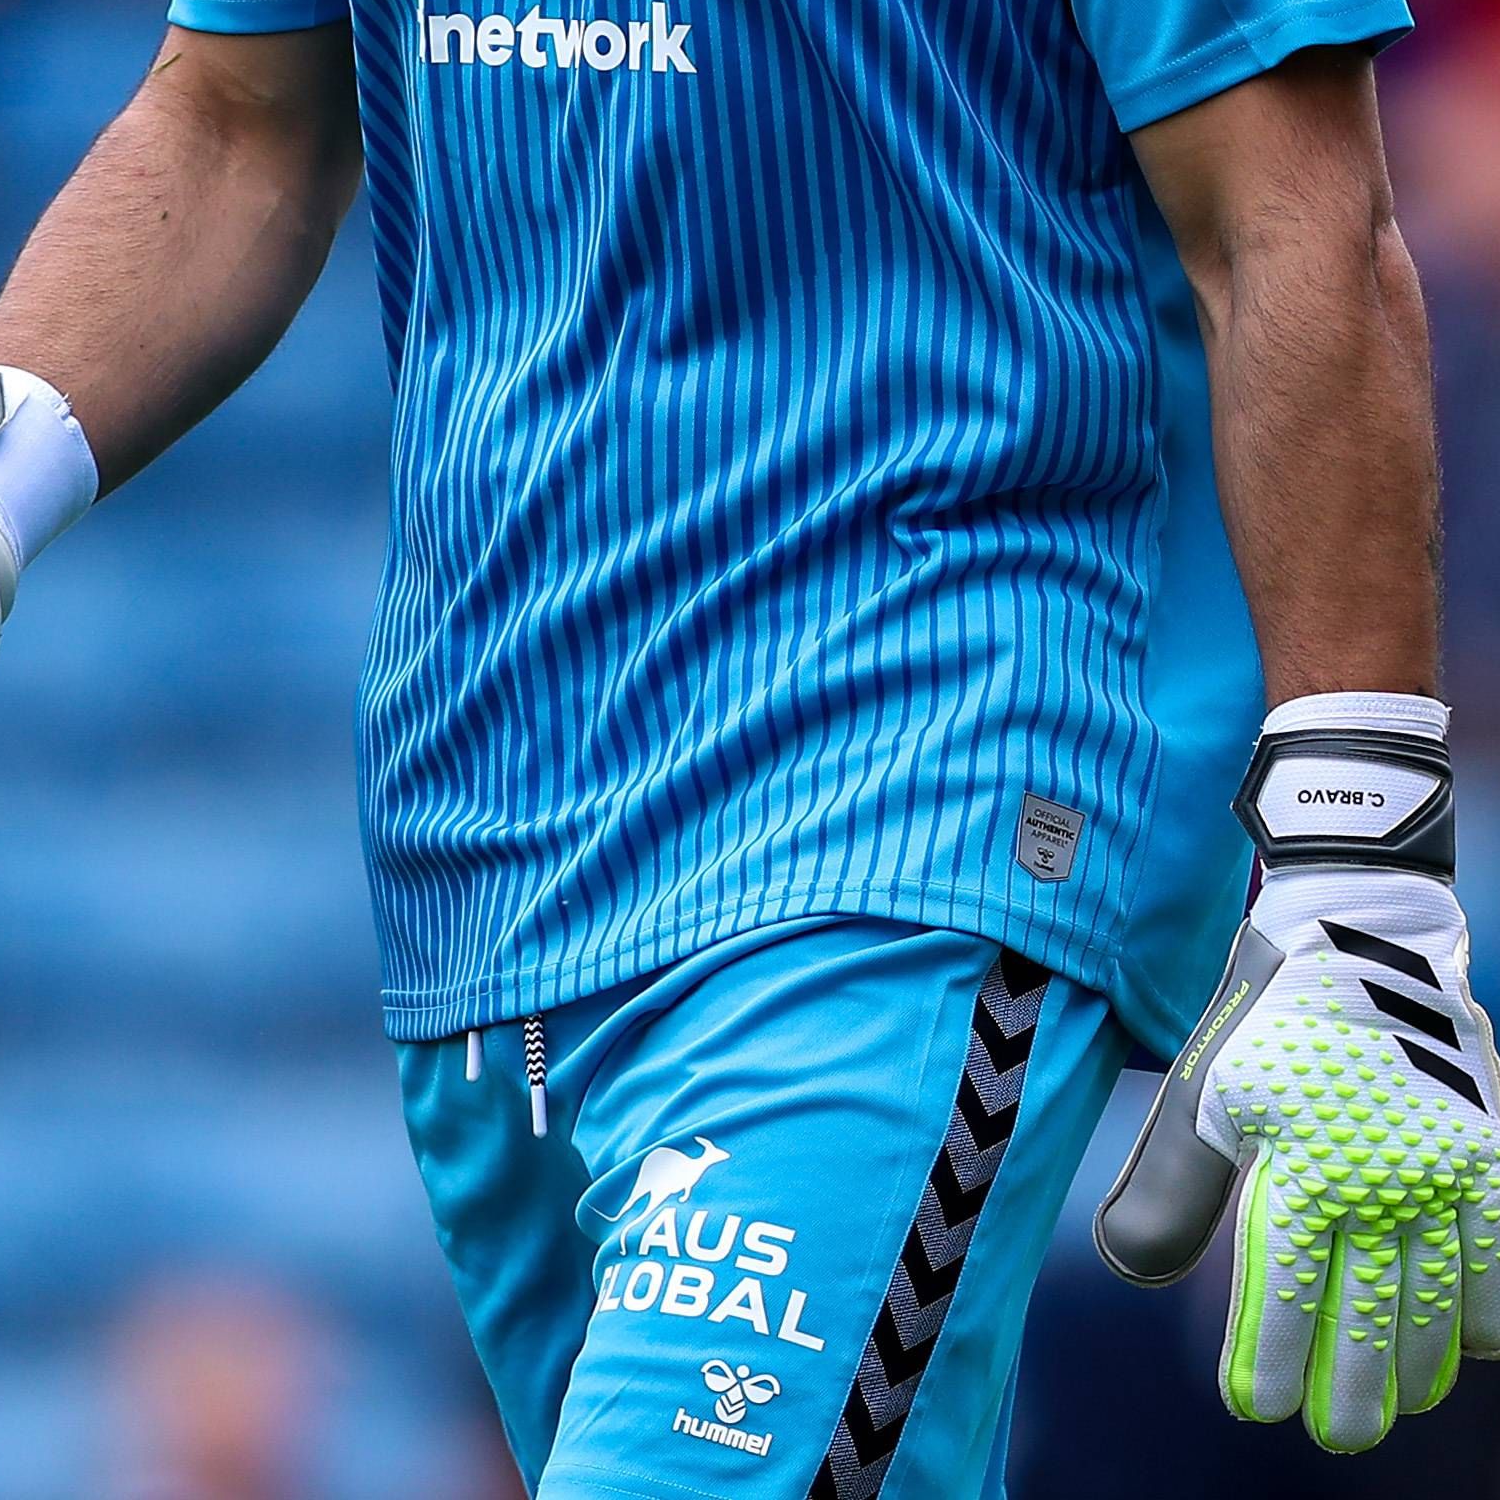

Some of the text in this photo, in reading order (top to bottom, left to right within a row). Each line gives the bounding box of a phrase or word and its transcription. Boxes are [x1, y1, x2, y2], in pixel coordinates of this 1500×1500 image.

[1297, 789, 1365, 806] BRAVO
[1179, 979, 1251, 1082] PREDATOR
[638, 1206, 796, 1277] AUS
[672, 1406, 774, 1458] hummel
